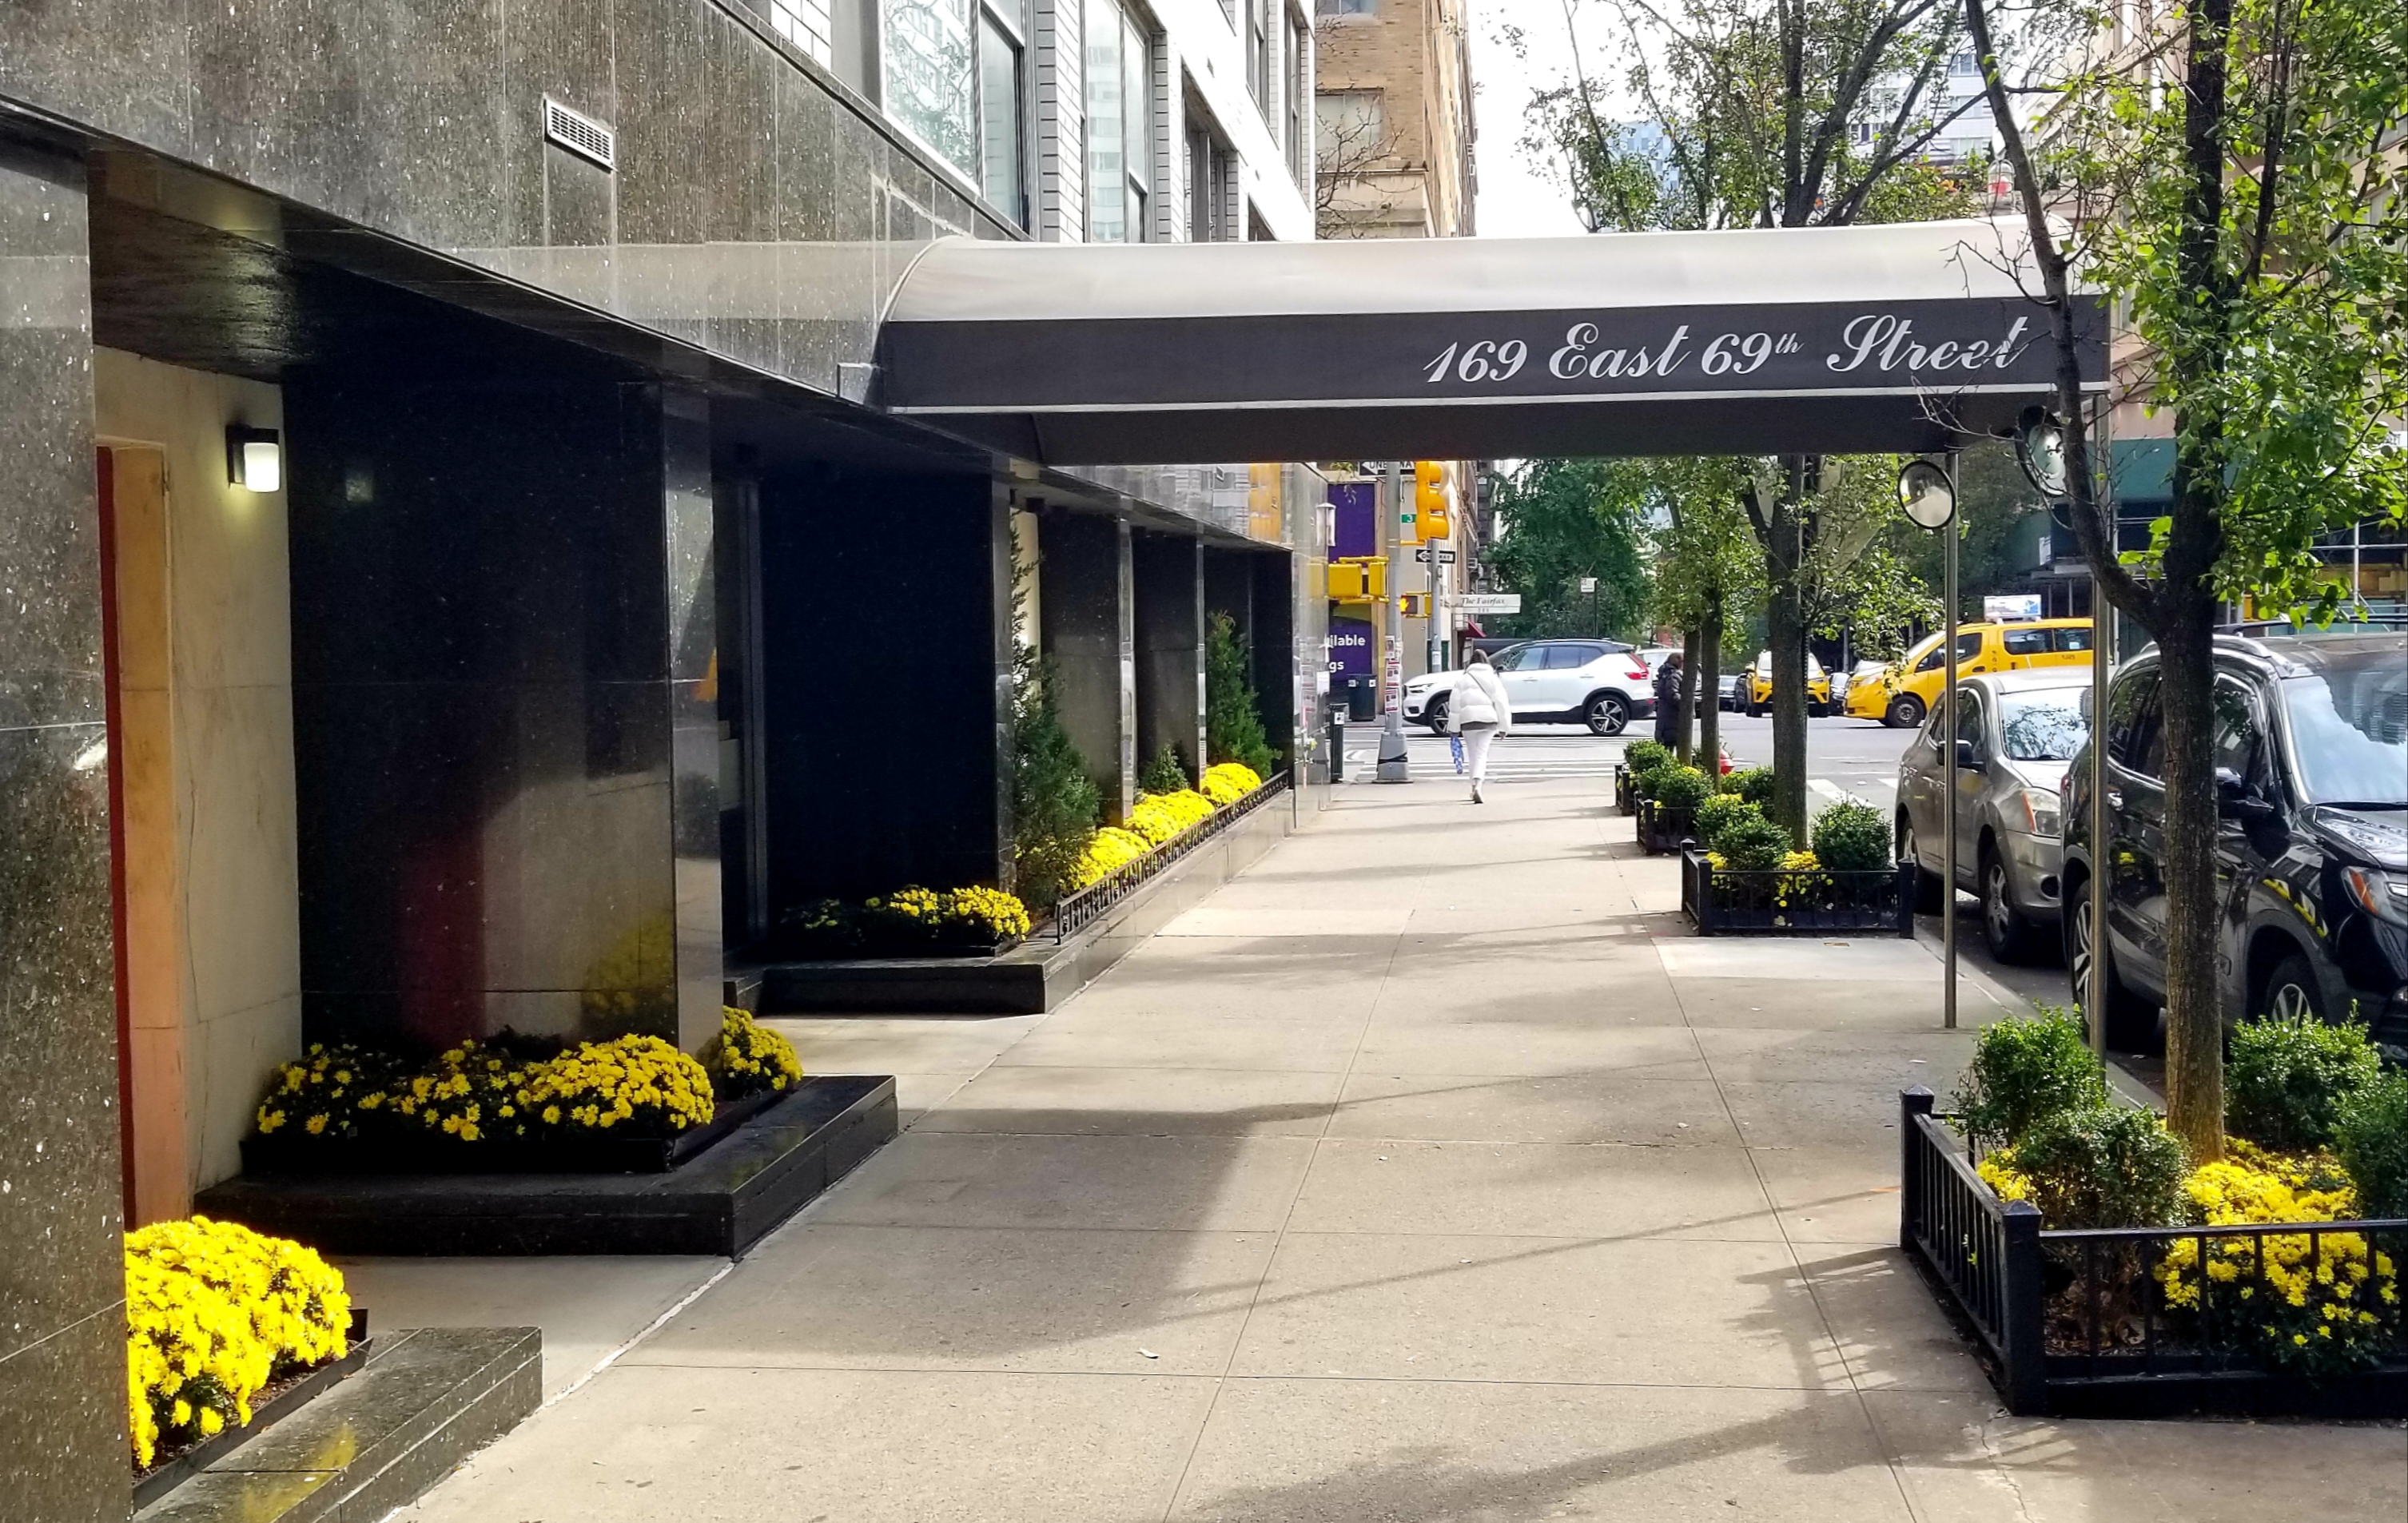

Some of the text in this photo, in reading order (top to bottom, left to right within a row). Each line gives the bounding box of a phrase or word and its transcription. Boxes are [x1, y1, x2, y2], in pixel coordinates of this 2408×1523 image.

[1423, 314, 2030, 383] 169 East 69th Street
[1407, 514, 1413, 523] 3
[1477, 597, 1506, 607] Fairfax
